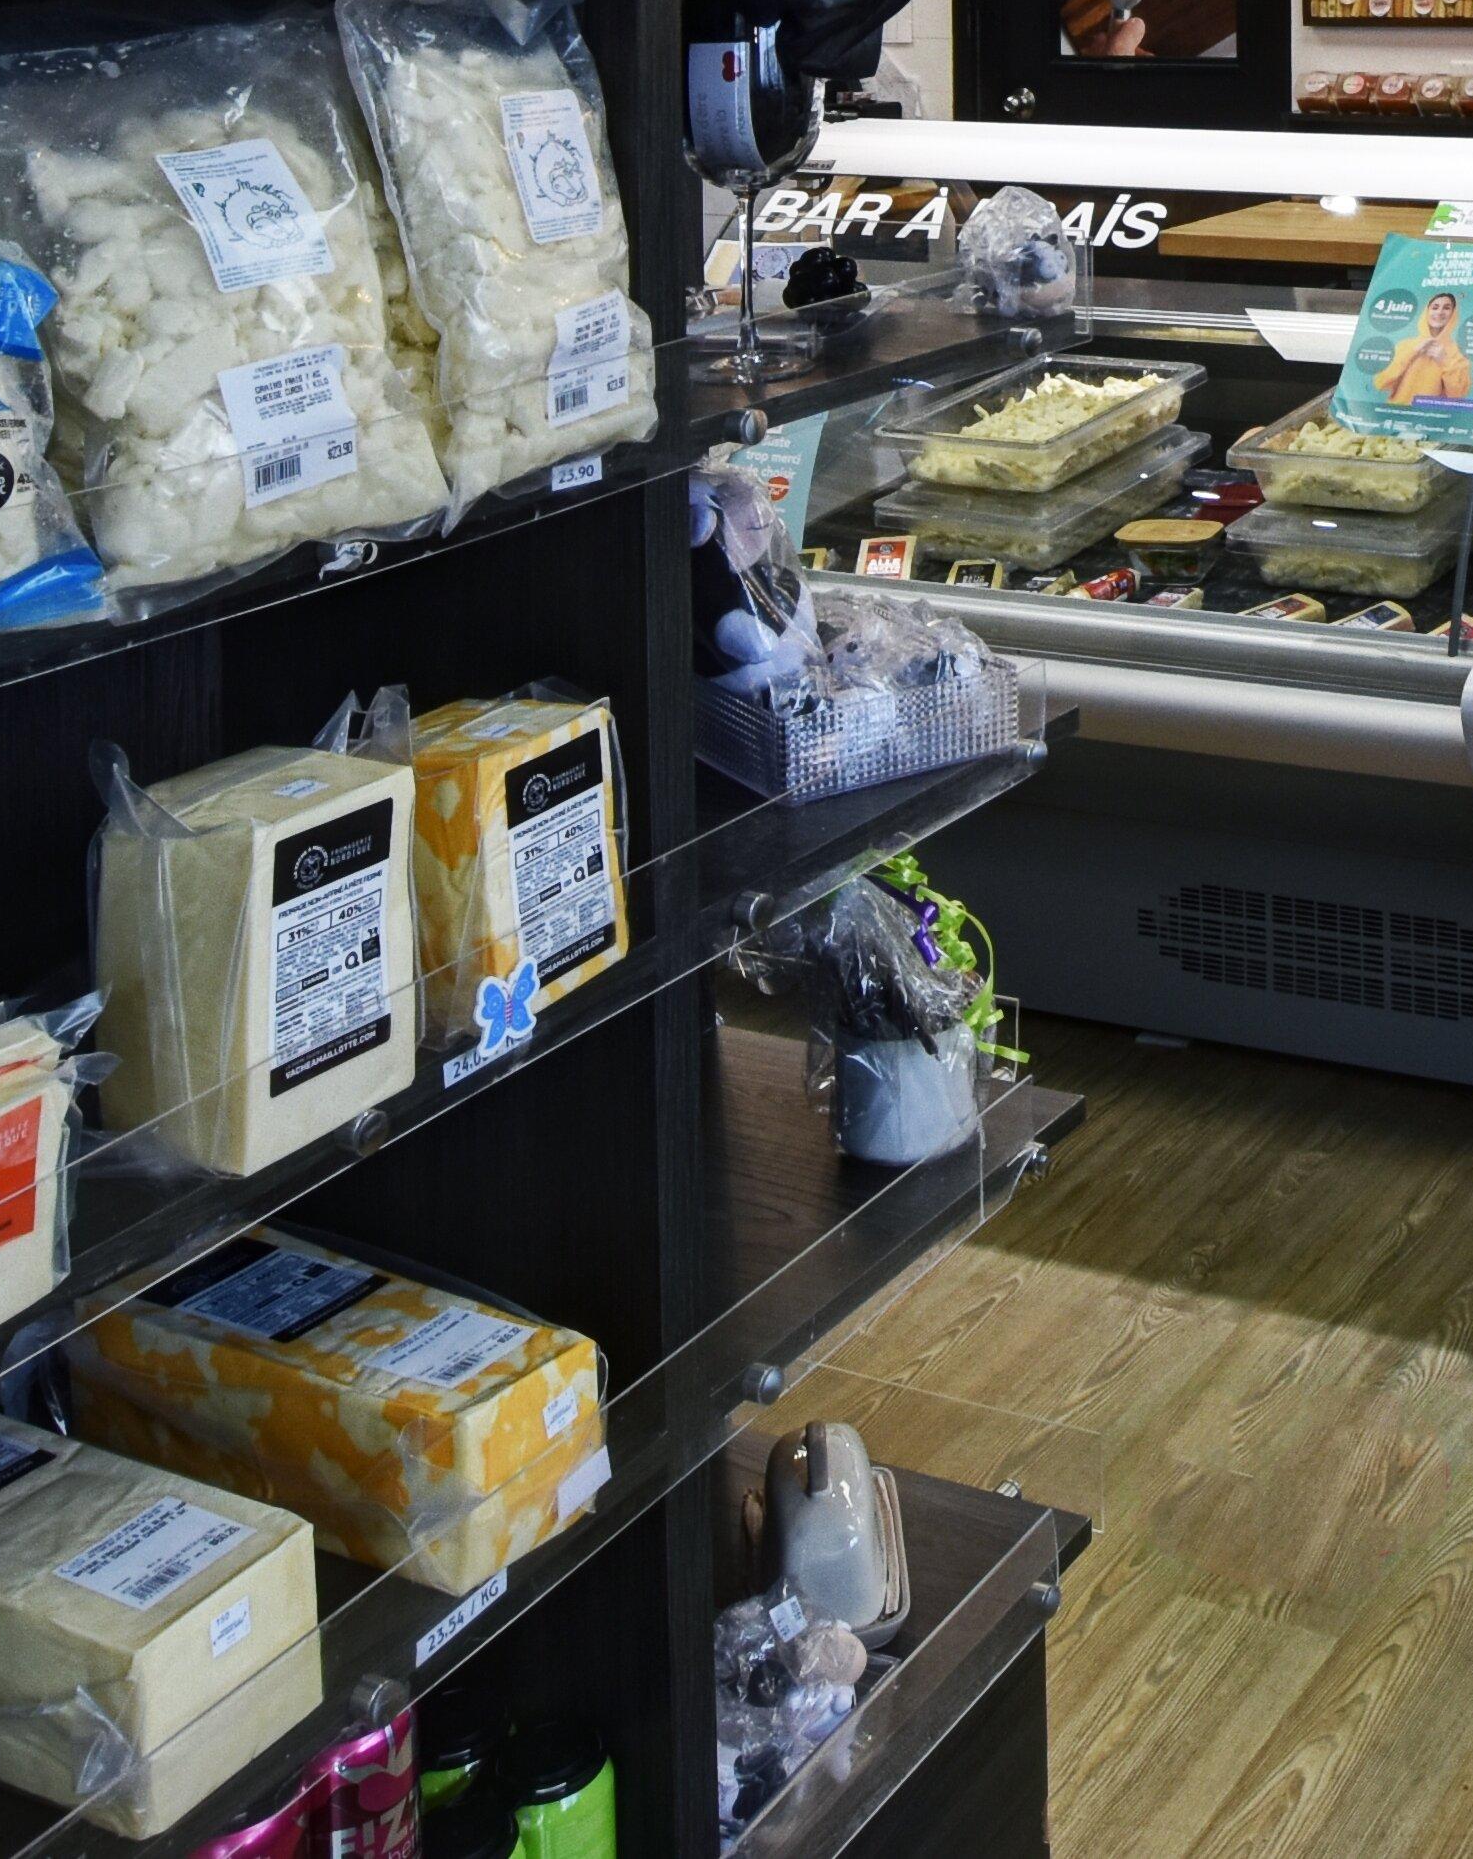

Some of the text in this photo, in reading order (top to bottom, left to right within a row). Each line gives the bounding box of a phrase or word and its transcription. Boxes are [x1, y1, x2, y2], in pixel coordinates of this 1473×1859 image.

[752, 186, 949, 241] BAR À
[1374, 300, 1414, 313] 4 juin
[746, 450, 802, 464] trop merci
[331, 842, 373, 866] NORDIQUE
[285, 1029, 376, 1079] VACHEAMAILLOTTE.COM
[481, 1579, 499, 1607] KG
